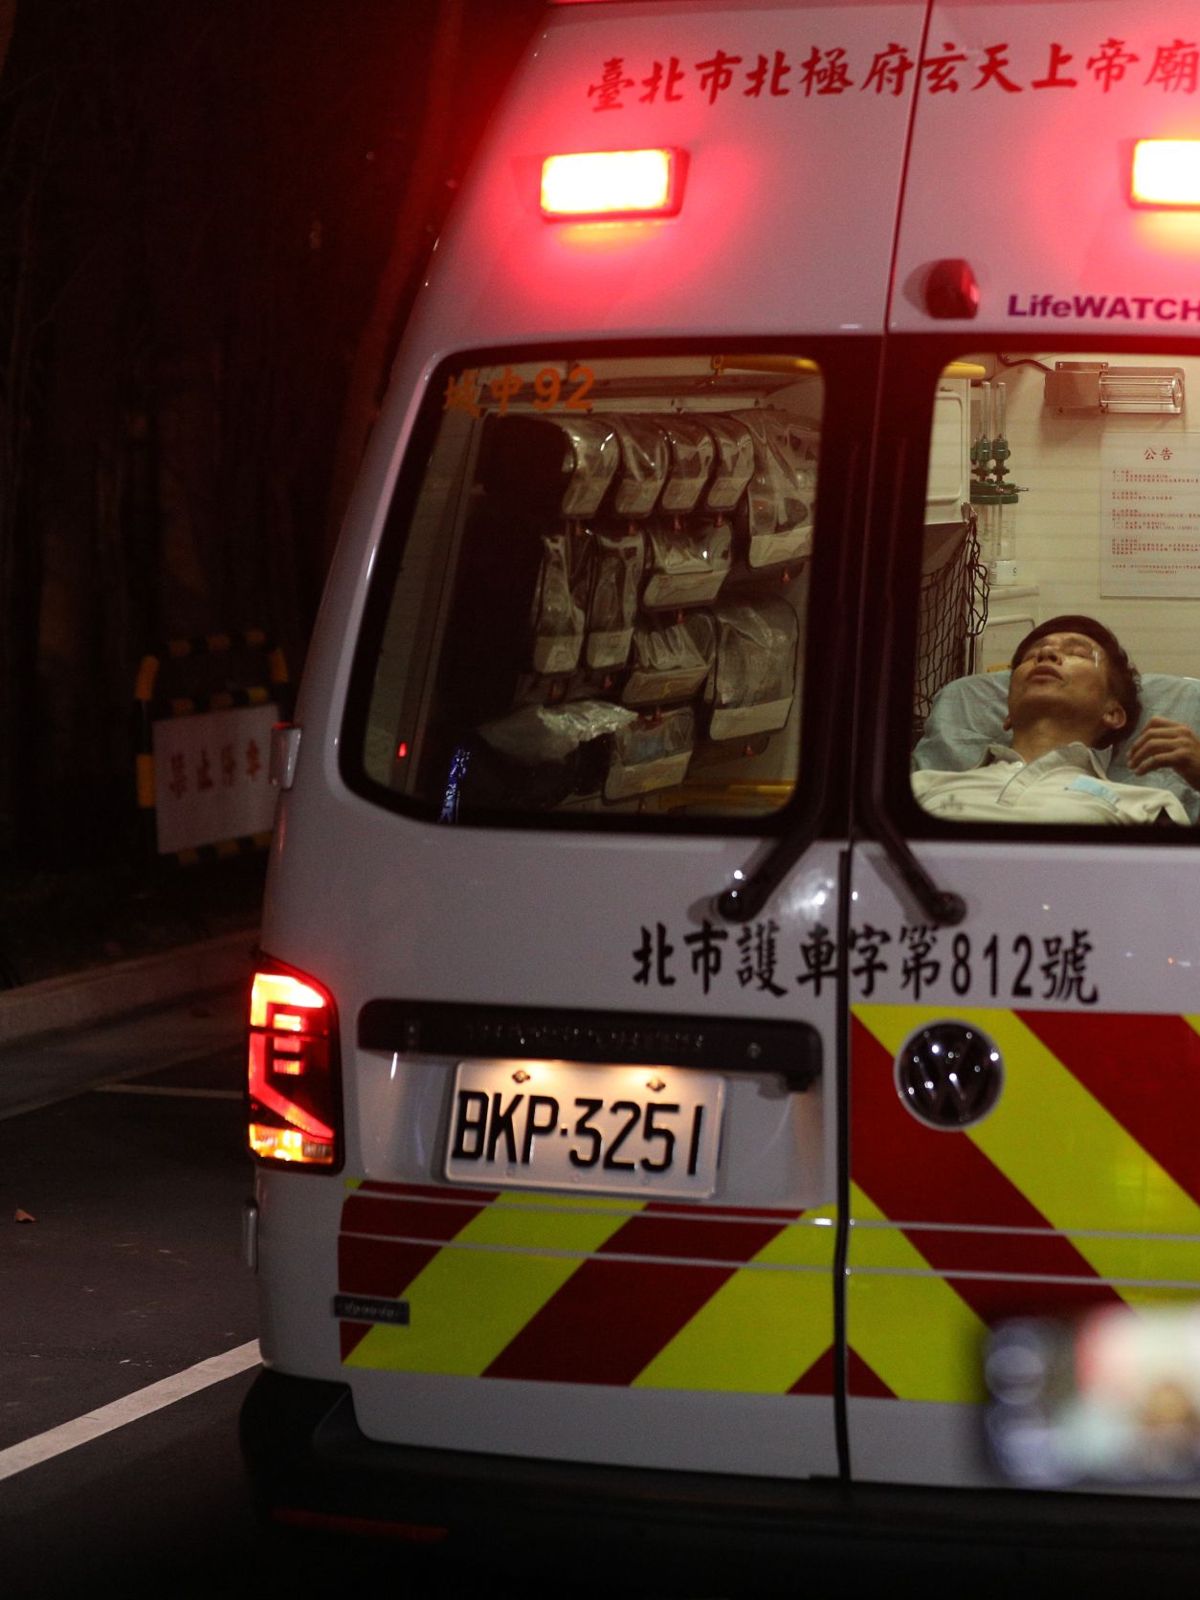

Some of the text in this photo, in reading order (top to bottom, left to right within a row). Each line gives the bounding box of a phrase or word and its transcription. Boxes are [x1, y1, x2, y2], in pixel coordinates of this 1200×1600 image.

[1143, 447, 1173, 461] 公告
[632, 919, 1098, 1003] 北市護車字第812號
